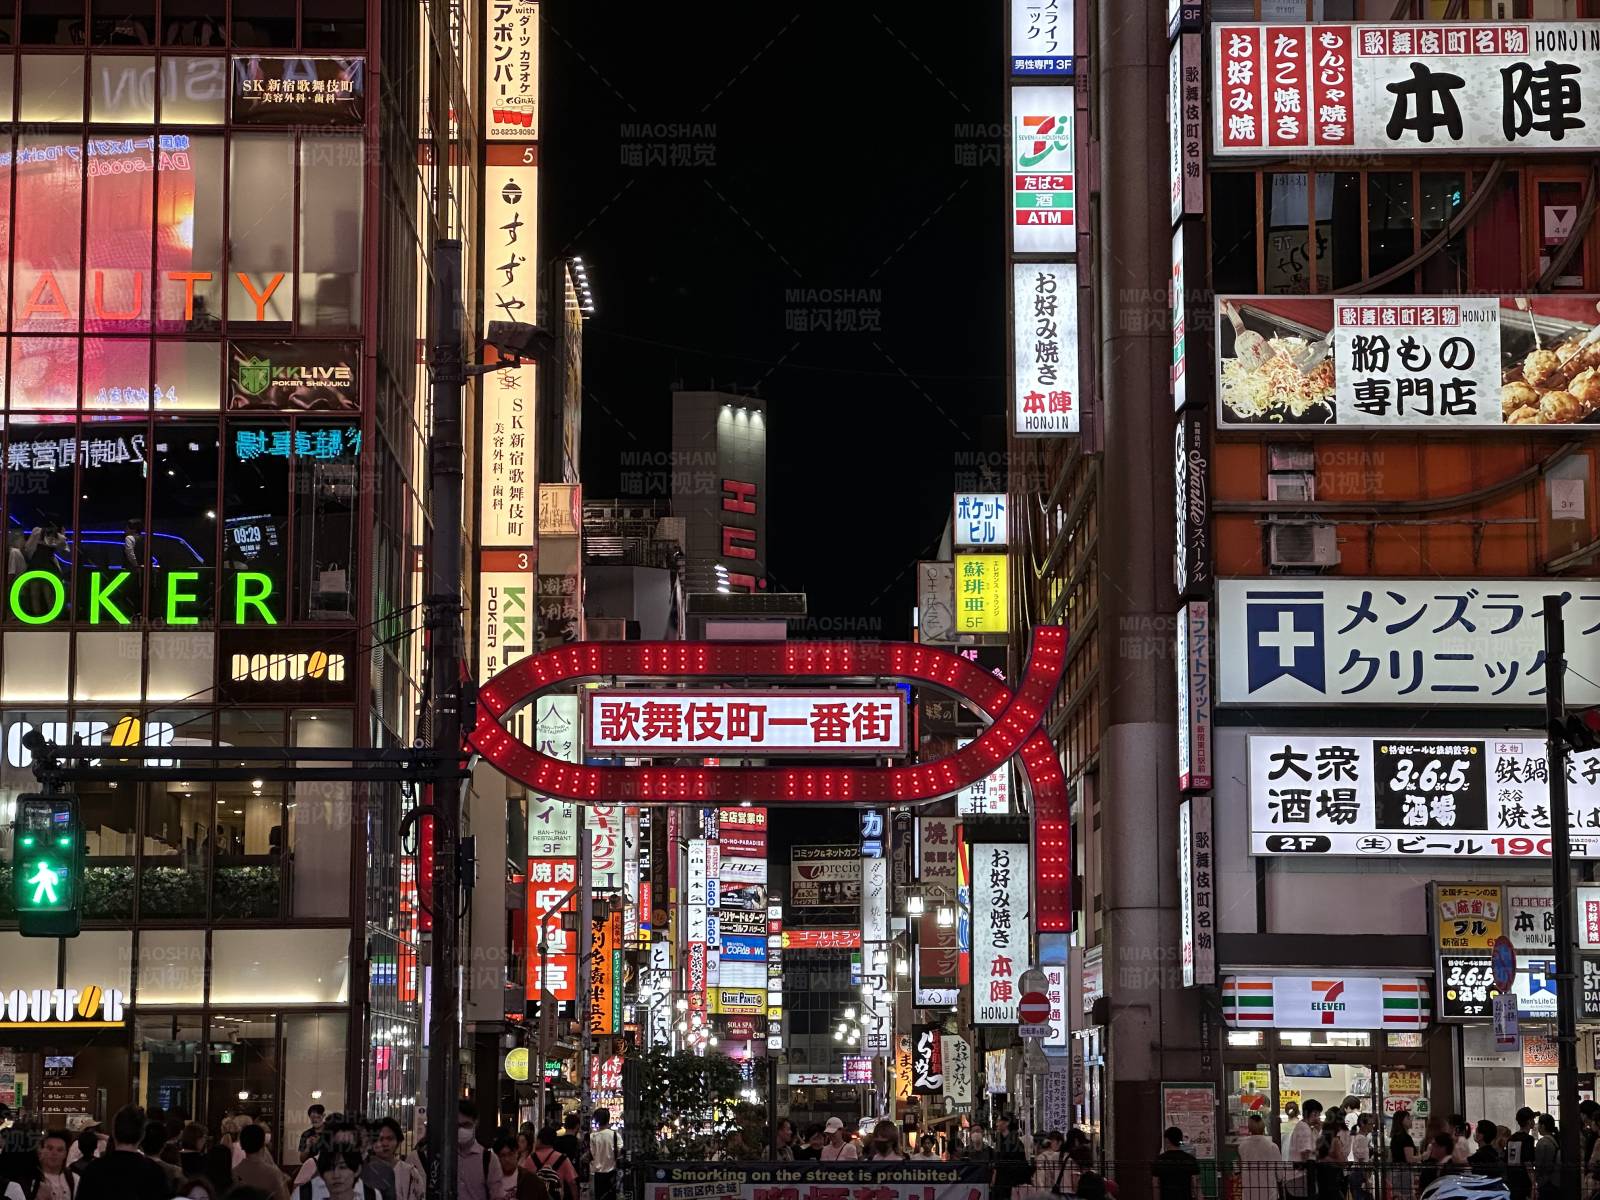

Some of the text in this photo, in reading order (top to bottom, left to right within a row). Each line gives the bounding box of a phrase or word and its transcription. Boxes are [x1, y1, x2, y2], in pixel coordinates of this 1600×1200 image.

[1184, 10, 1200, 20] 3F
[493, 0, 514, 95] アポンバー
[1363, 30, 1600, 54] 歌舞伎町名物 HONJIN
[1015, 60, 1072, 69] 男性専門 3F
[1226, 33, 1256, 141] お好み焼
[1273, 33, 1301, 140] たこ焼き
[1319, 31, 1347, 140] もんじゃ焼き
[1385, 60, 1586, 143] 本陣
[1185, 66, 1200, 178] 歌舞伎町名物
[522, 148, 534, 163] 5
[1024, 177, 1065, 189] たばこ
[1036, 194, 1053, 207] 酒
[1027, 212, 1062, 223] ATM
[496, 212, 526, 321] すずや
[1340, 307, 1497, 325] 歌舞伎町名物 HONJIN
[1034, 272, 1059, 386] お好み焼き
[1351, 334, 1477, 373] 粉もの
[272, 367, 350, 379] KKLIVE
[1023, 391, 1073, 414] 本陣
[1352, 377, 1478, 416] 専門店
[1025, 416, 1069, 429] HONJIN
[508, 398, 525, 537] SK新宿歌舞伎町
[1189, 450, 1207, 526] Sparkle
[958, 497, 1005, 520] ポケット
[1561, 501, 1574, 509] 3F
[234, 525, 261, 544] 09:29
[518, 553, 528, 569] 3
[10, 570, 277, 625] OKER
[487, 587, 497, 648] POKER
[966, 617, 984, 628] 5F
[232, 651, 344, 681] DOUTOR
[600, 701, 893, 743] 歌舞伎町一番街
[1498, 744, 1520, 752] 名物
[1267, 744, 1361, 782] 大衆
[1498, 789, 1524, 803] 渋谷
[1267, 788, 1361, 825] 酒場
[1402, 795, 1457, 827] 酒場
[719, 811, 765, 825] 全店営業中
[543, 844, 561, 853] 3F
[1280, 839, 1315, 851] 2F
[1362, 838, 1384, 850] 生
[1397, 835, 1484, 855] ビール
[530, 863, 575, 883] 焼肉
[720, 862, 764, 872] FACE
[707, 880, 716, 906] GiGO
[990, 849, 1011, 949] お好み焼き
[1195, 831, 1212, 950] 歌舞伎町名物
[1441, 889, 1498, 898] 全国チェーンの店
[1456, 900, 1483, 915] 麻雀
[707, 918, 716, 945] GiGO
[1442, 938, 1469, 947] 新宿店
[990, 955, 1013, 1003] 本陣
[722, 991, 756, 1004] GAME PANIC
[1458, 986, 1487, 1002] 酒場
[981, 1006, 1018, 1019] HONJI
[1464, 1005, 1484, 1014] 2F
[798, 1075, 825, 1083] コーヒー
[1385, 1100, 1428, 1112] たばこ 酒
[671, 1168, 962, 1184] Smorking on the street is prohibited.
